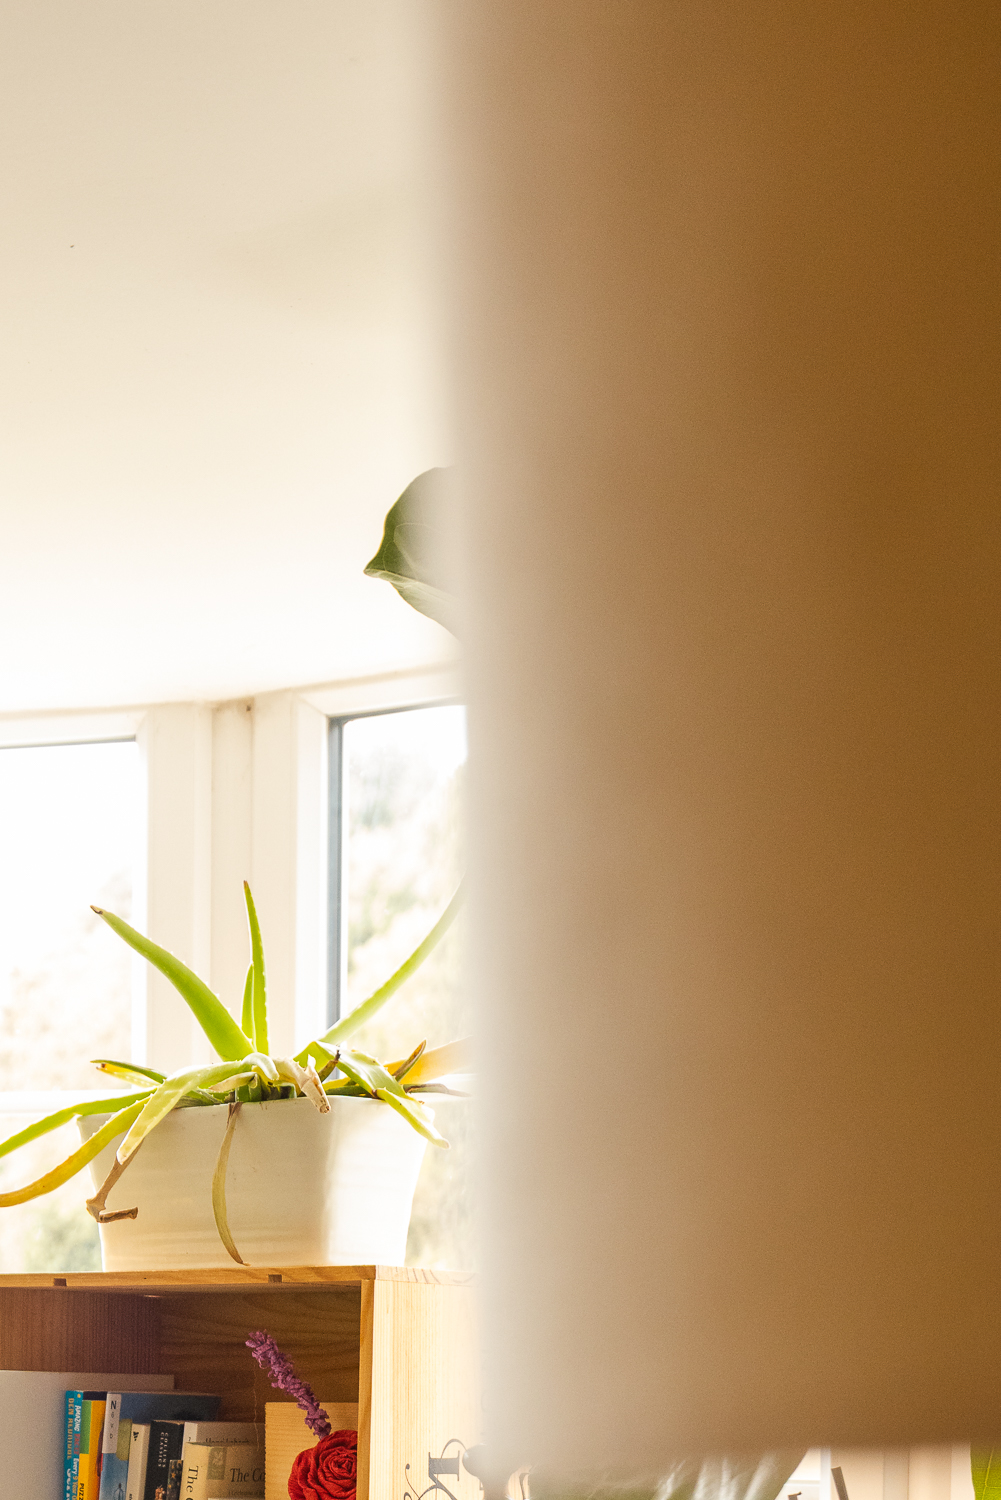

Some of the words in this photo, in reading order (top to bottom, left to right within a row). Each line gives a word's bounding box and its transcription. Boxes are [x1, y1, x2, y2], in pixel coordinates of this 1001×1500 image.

[73, 1405, 82, 1432] AMAZING
[71, 1457, 80, 1475] Every
[230, 1468, 250, 1483] The
[186, 1465, 199, 1493] The
